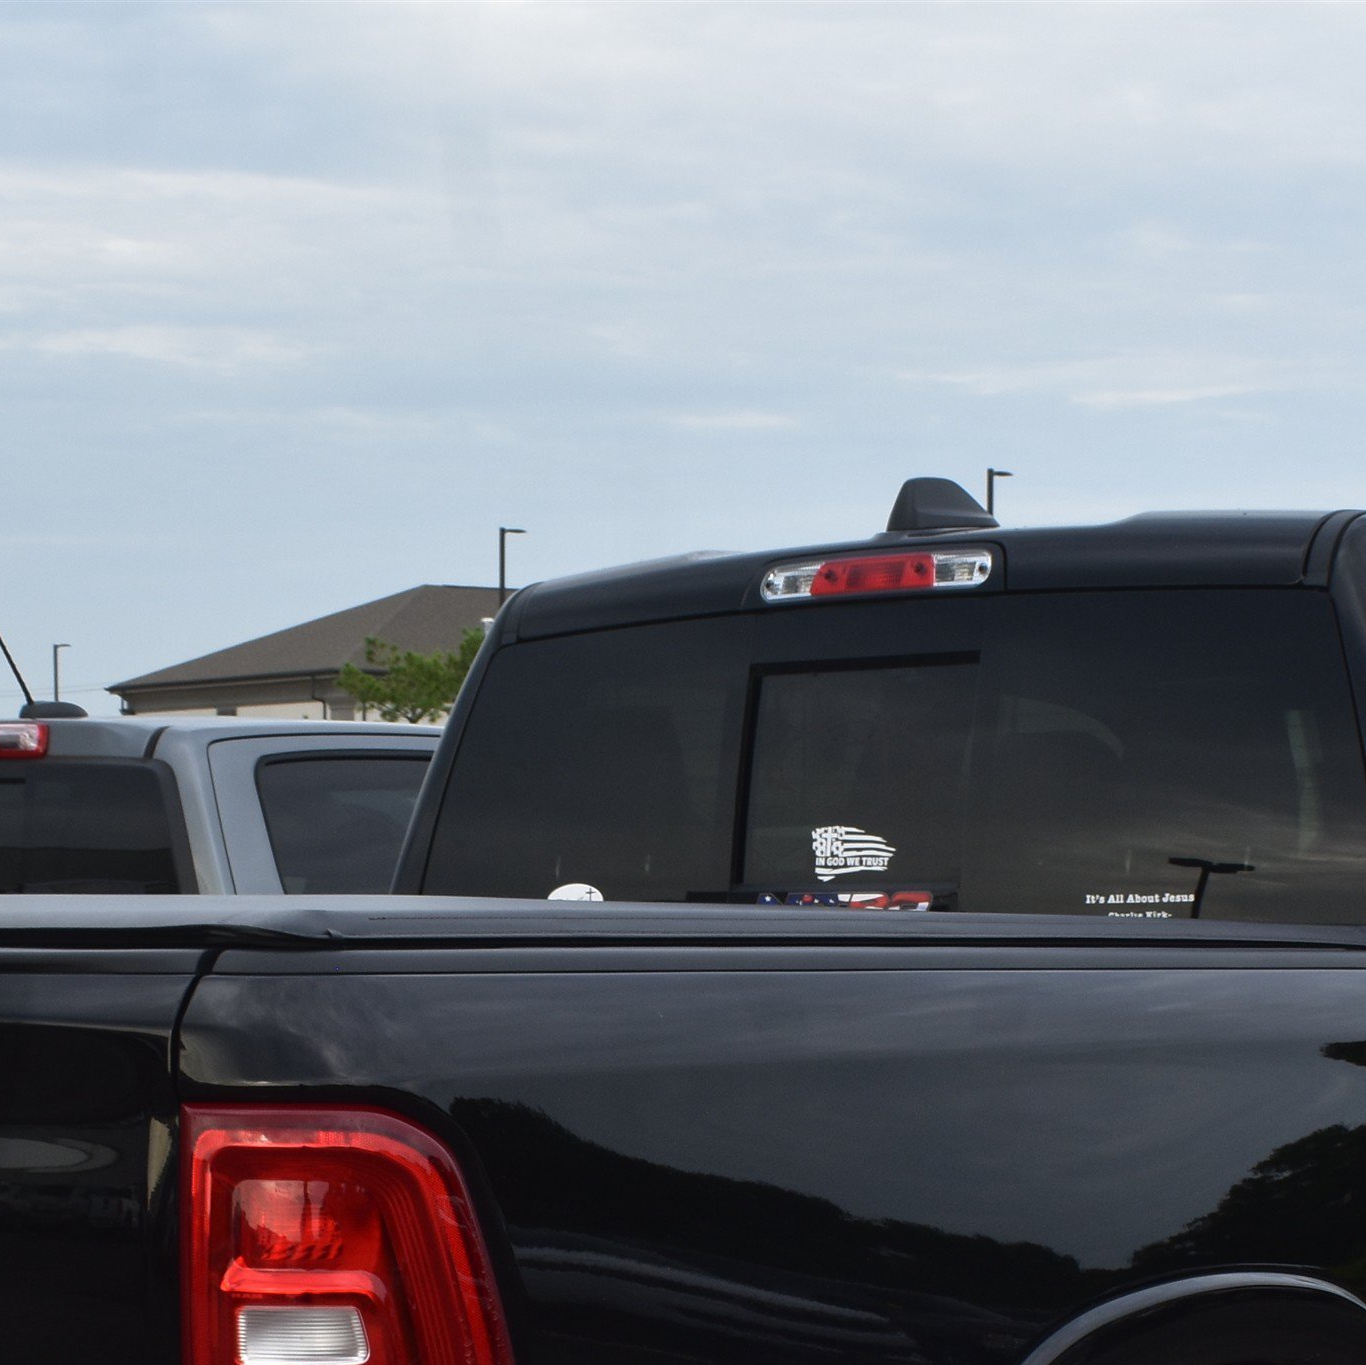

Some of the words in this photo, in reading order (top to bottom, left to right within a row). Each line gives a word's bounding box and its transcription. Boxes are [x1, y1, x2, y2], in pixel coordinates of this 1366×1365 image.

[815, 857, 825, 866] IN
[826, 857, 845, 866] GOD
[846, 857, 861, 866] WE
[862, 857, 889, 866] TRUST
[1085, 894, 1105, 904] It's
[1107, 894, 1125, 904] All
[1126, 894, 1160, 904] About
[1162, 893, 1195, 903] Jesus
